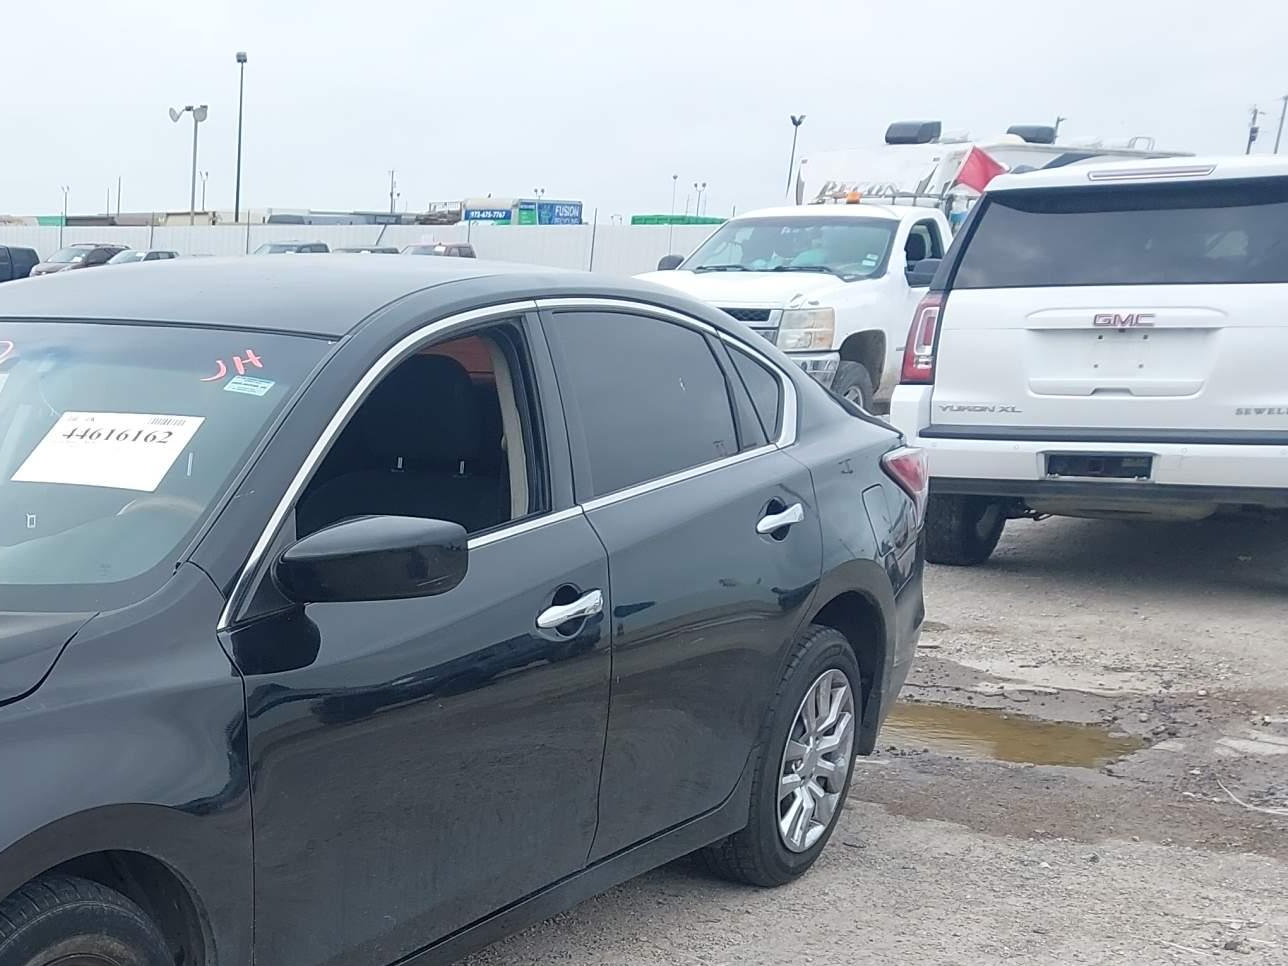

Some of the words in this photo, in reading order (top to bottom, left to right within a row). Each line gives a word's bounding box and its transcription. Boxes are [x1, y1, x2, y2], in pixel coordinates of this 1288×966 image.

[555, 205, 579, 217] FUSION
[1093, 313, 1155, 327] GMC
[938, 405, 996, 413] YUKON
[998, 405, 1023, 413] XL
[1235, 407, 1288, 416] SEWEL
[62, 427, 174, 444] 44616162
